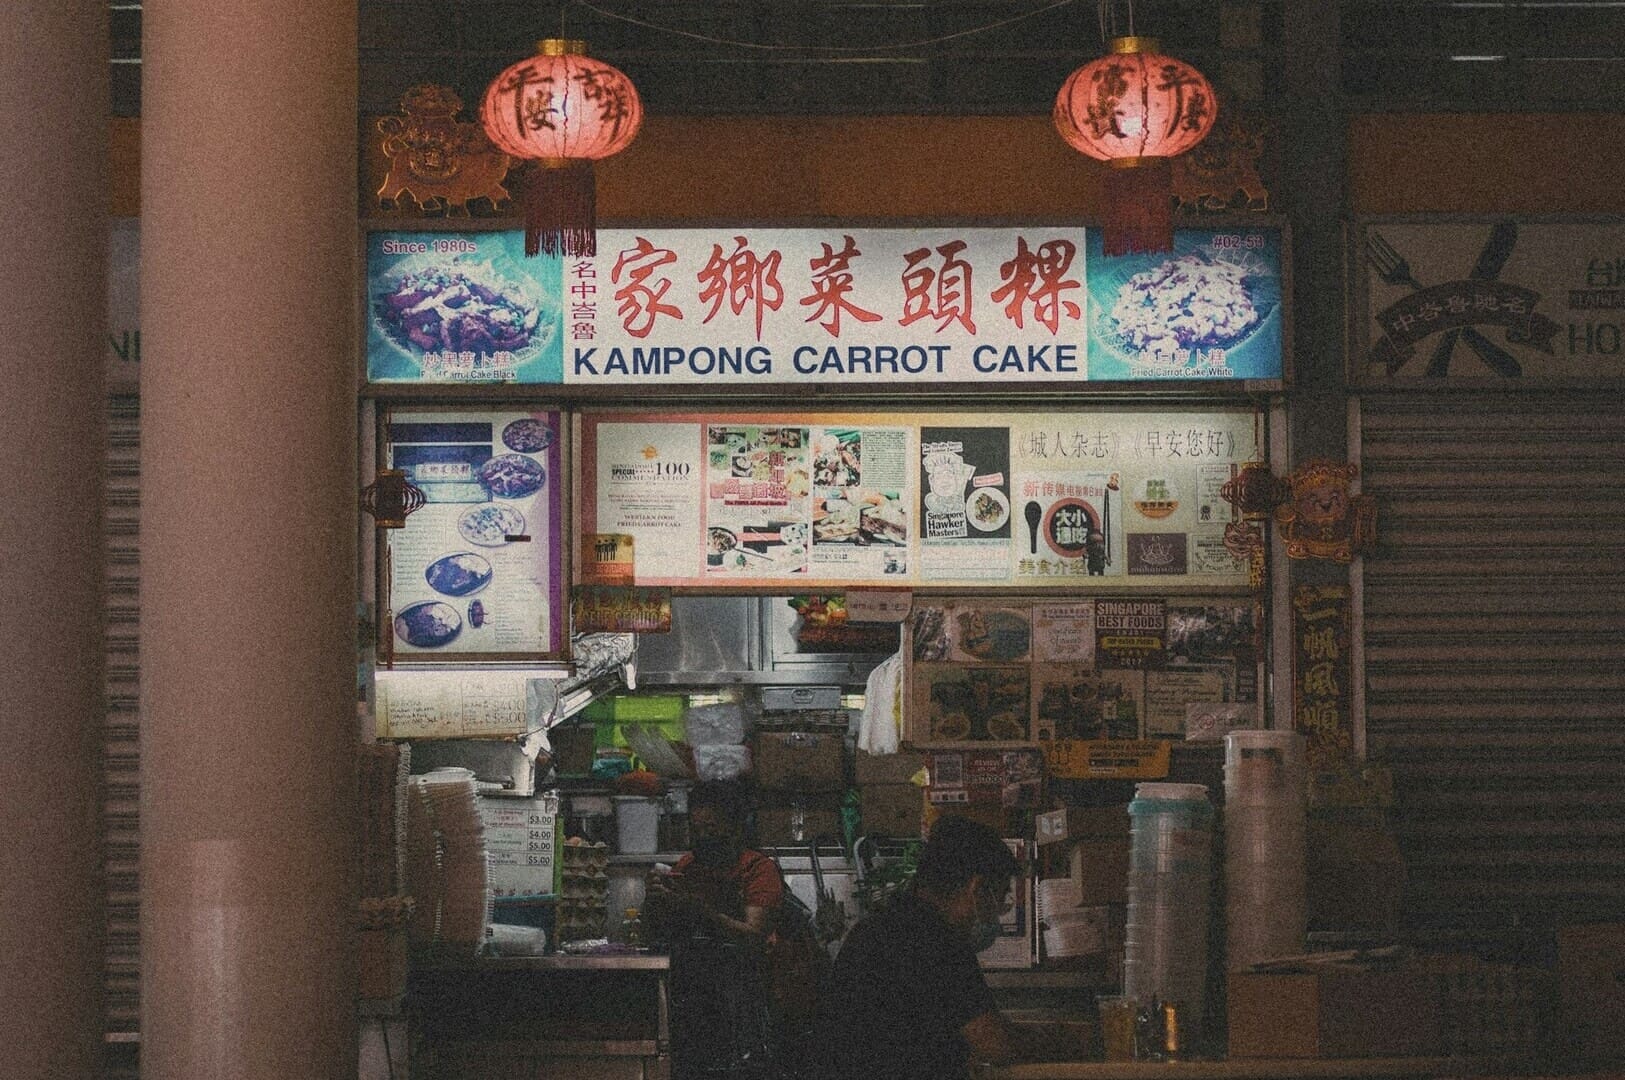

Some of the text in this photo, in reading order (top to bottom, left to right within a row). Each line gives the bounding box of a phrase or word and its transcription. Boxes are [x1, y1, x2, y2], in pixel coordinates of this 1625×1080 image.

[382, 240, 477, 255] Since 1980s
[574, 344, 1078, 375] KAMPONG CARROT CAKE
[1132, 367, 1233, 377] Fried Carrot Cake White
[1136, 428, 1235, 458] 《早安您好》
[657, 462, 690, 476] 100
[928, 511, 964, 522] Singapore
[1055, 509, 1087, 527] 大小
[928, 518, 965, 530] Hawker
[928, 529, 960, 537] Masters
[1097, 602, 1165, 616] SINGAPORE
[1098, 616, 1162, 628] BEST FOODS
[530, 816, 552, 825] $3.00
[529, 831, 551, 840] $4.00
[529, 842, 551, 851] $5.00
[528, 855, 550, 865] $5.00
